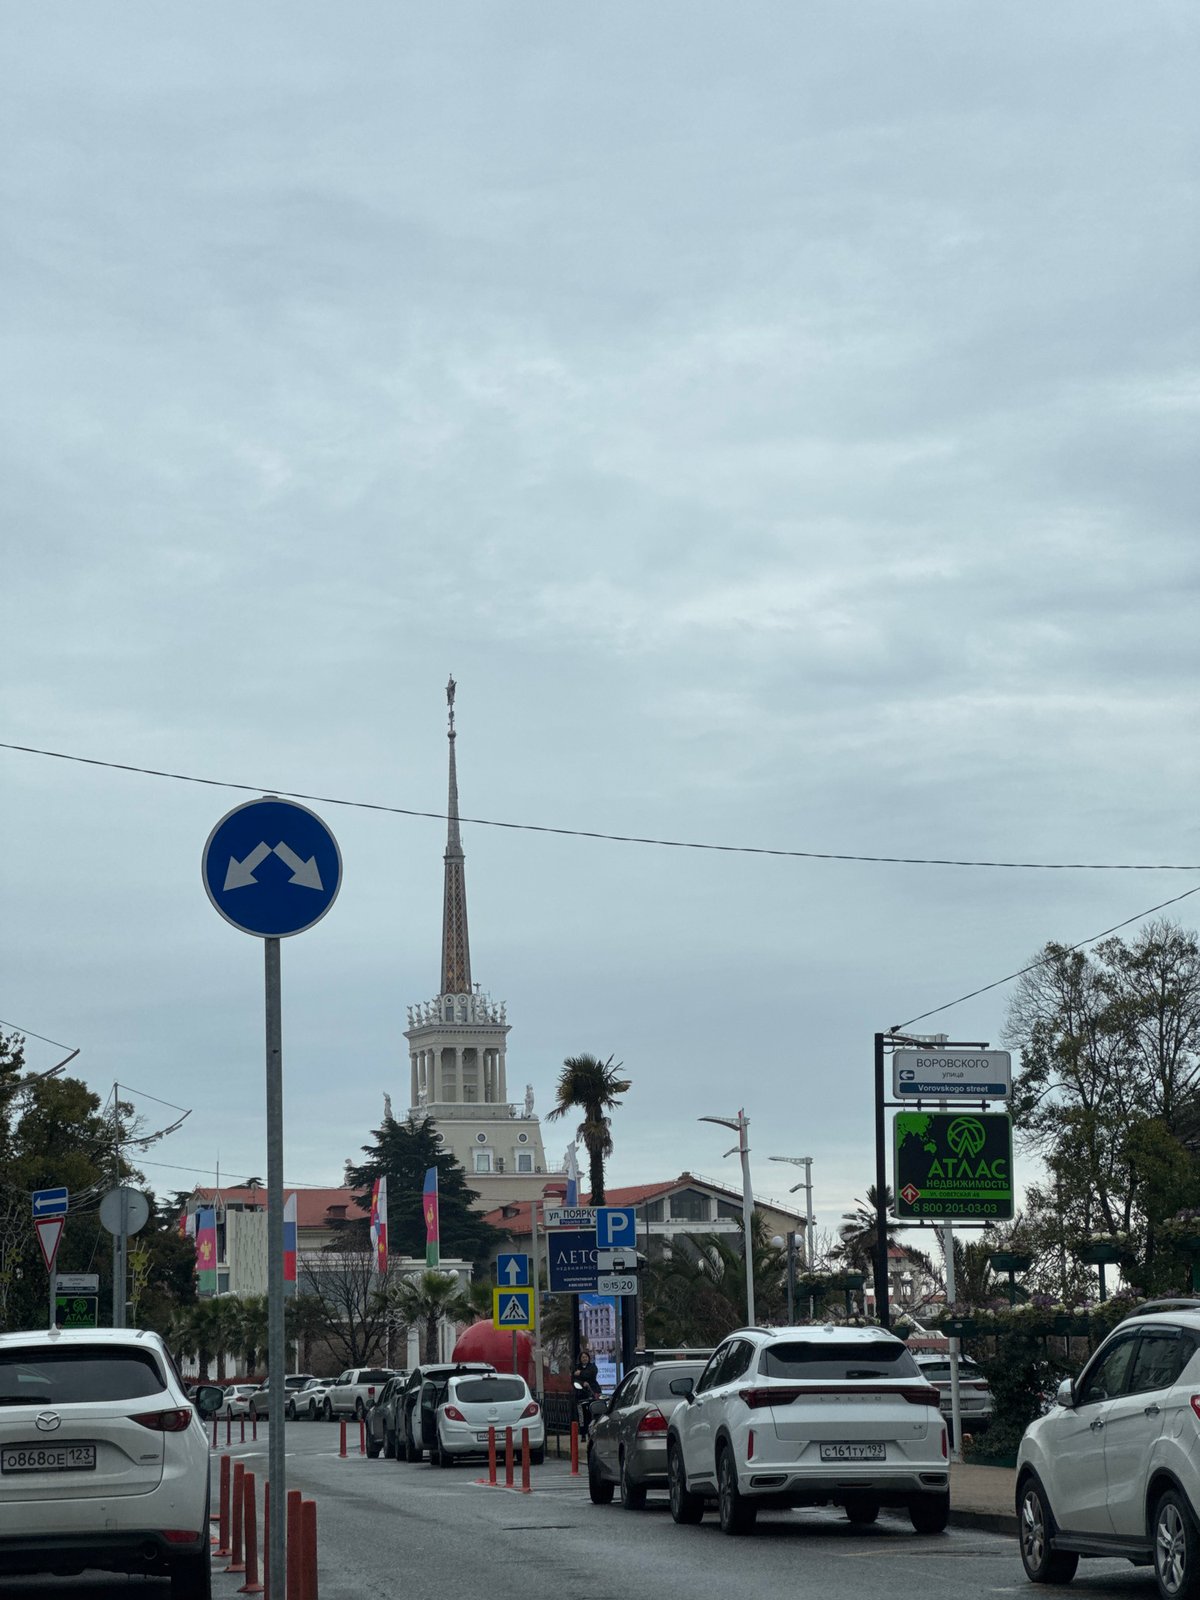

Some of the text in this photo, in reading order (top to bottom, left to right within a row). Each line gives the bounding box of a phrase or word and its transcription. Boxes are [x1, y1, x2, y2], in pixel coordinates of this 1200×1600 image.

[916, 1058, 989, 1068] ВОРОВСКОГО
[918, 1084, 989, 1093] Vorovskogo street
[928, 1158, 1007, 1179] АТЛАС
[912, 1203, 998, 1213] 8 800 201-03-03
[549, 1212, 561, 1220] ул.
[607, 1212, 629, 1243] P
[621, 1281, 633, 1290] 20
[824, 1445, 883, 1457] С161ТУ 193
[7, 1448, 90, 1467] О868ОЕ 123
